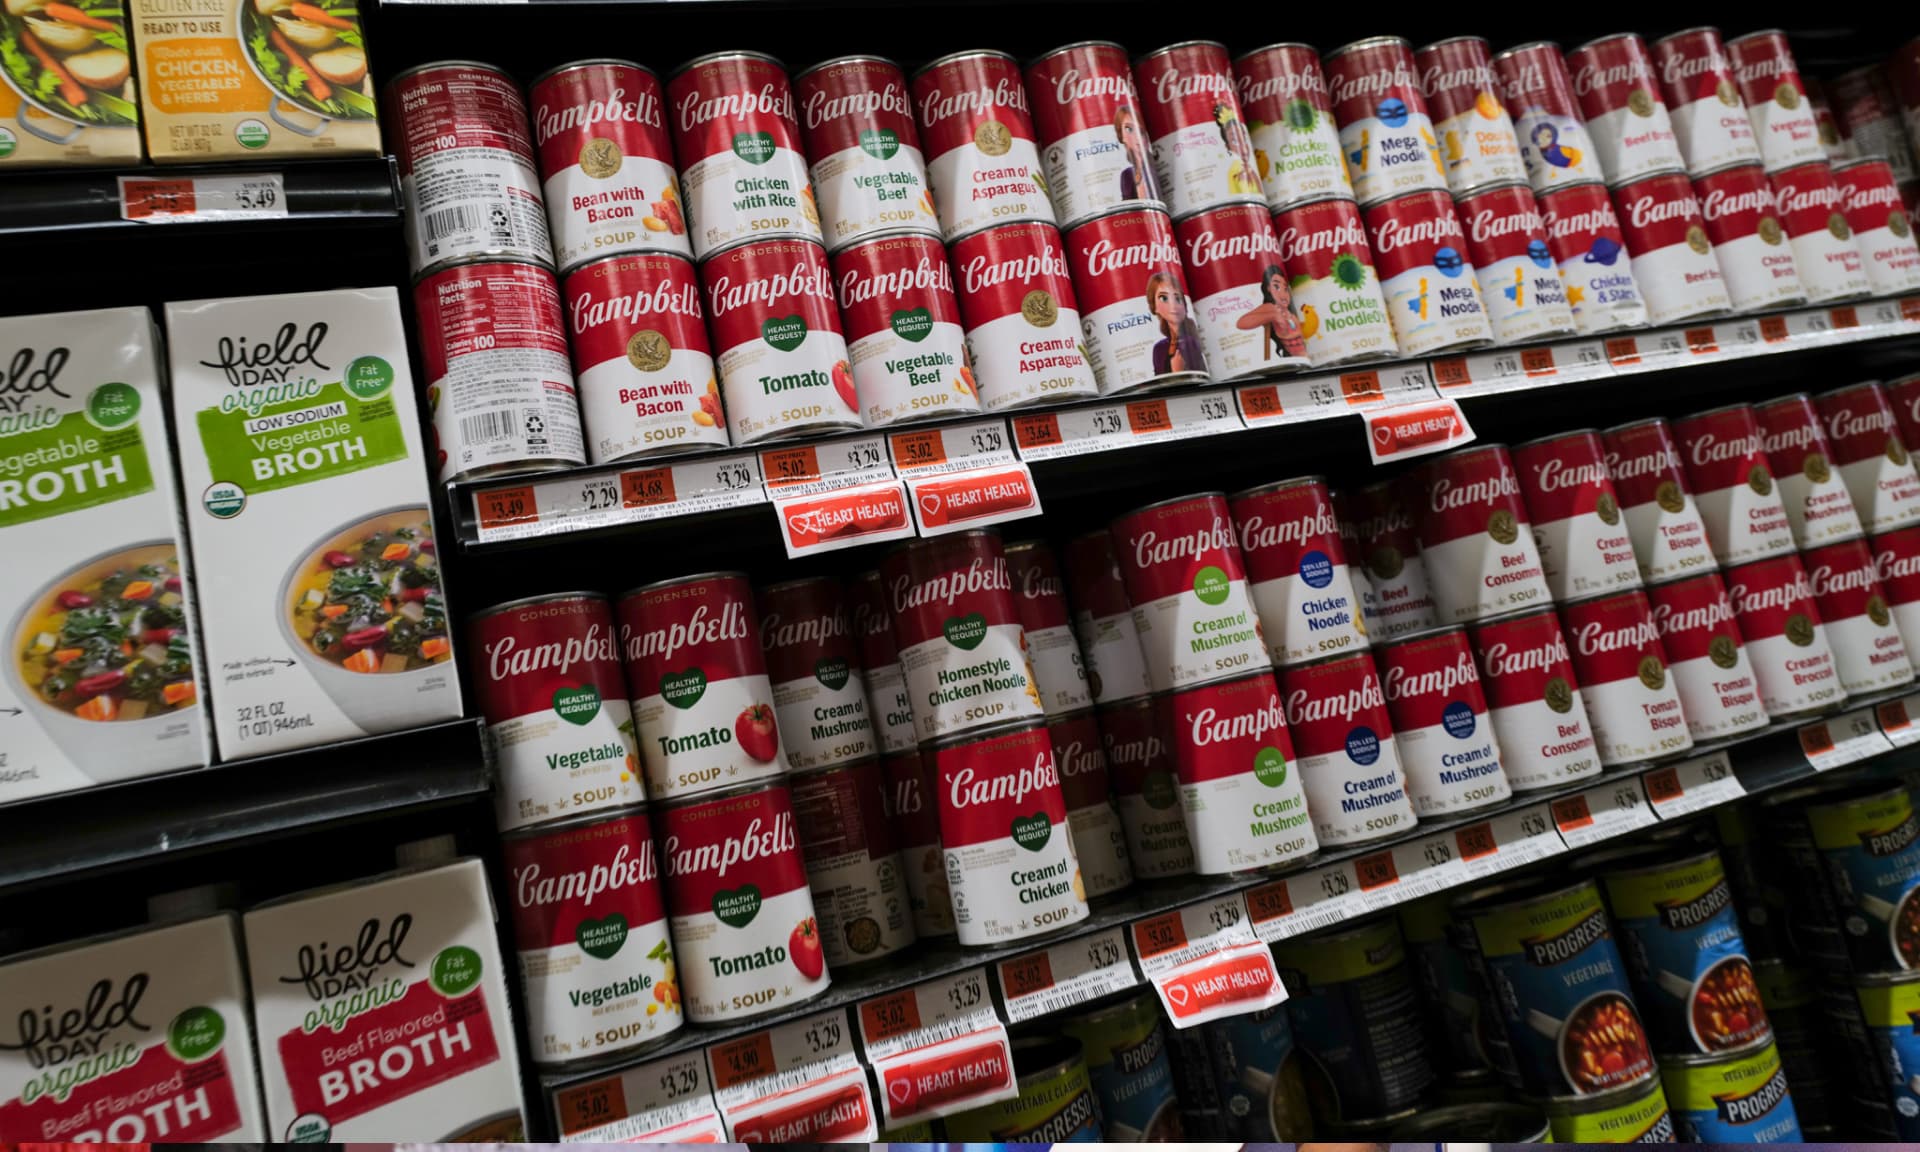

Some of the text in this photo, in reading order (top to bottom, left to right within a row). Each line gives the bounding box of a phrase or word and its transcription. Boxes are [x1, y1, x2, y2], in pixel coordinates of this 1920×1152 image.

[144, 22, 222, 34] READY TO USE
[156, 60, 245, 78] CHICKEN,
[159, 77, 241, 91] VEGETABLES
[402, 84, 442, 100] Nutrition
[161, 92, 219, 104] & HERBS
[405, 97, 428, 112] Facts
[435, 135, 456, 149] 100
[1075, 142, 1121, 161] FROZEN
[1379, 136, 1418, 153] Mega
[854, 171, 919, 189] Vegetable
[973, 166, 1028, 182] Cream of
[735, 178, 789, 193] Chicken
[877, 187, 907, 200] Beef
[972, 181, 1037, 201] Asparagus
[572, 186, 644, 210] Bean with
[733, 192, 796, 210] with Rice
[588, 206, 634, 223] Bacon
[594, 262, 670, 277] CONDENSED
[439, 280, 481, 294] Nutrition
[1440, 287, 1473, 302] Mega
[440, 293, 465, 305] Facts
[1329, 296, 1378, 316] Chicken
[1441, 301, 1482, 317] Noodle
[768, 322, 801, 336] HEALTHY
[896, 316, 928, 326] HEALTHY
[1107, 314, 1153, 334] FROZEN
[447, 335, 495, 349] Calories 100
[1020, 337, 1075, 355] Cream of
[200, 322, 331, 386] field
[885, 352, 954, 374] Vegetable
[1019, 354, 1082, 373] Asparagus
[244, 365, 292, 386] DAY
[359, 365, 378, 376] Fat
[909, 369, 941, 387] Beef
[759, 369, 830, 395] Tomato
[1040, 377, 1075, 391] SOUP
[103, 393, 124, 404] Fat
[222, 377, 322, 414] organic
[619, 381, 692, 404] Bean with
[249, 417, 283, 432] LOW
[286, 404, 344, 428] SODIUM
[636, 400, 683, 417] Bacon
[1025, 427, 1050, 440] $3.64
[1093, 415, 1122, 434] $2.39
[1394, 416, 1457, 438] HEART HEALTH
[252, 420, 351, 452] Vegetable
[971, 433, 1001, 453] $3.29
[252, 437, 367, 481] BROTH
[907, 443, 932, 459] $5.02
[582, 486, 618, 511] $2.29
[632, 480, 663, 497] $4.68
[946, 482, 1026, 508] HEART HEALTH
[491, 501, 524, 518] $3.49
[817, 502, 900, 528] HEART HEALTH
[1501, 553, 1527, 568] Beef
[1302, 596, 1348, 615] Chicken
[1193, 611, 1248, 635] Cream of
[1308, 612, 1350, 632] Noodle
[1190, 627, 1255, 653] Mushroom
[1215, 653, 1250, 670] SOUP
[937, 658, 1011, 686] Homestyle
[665, 676, 700, 691] HEALTHY
[928, 673, 1027, 707] Chicken Noodle
[558, 693, 596, 707] HEALTHY
[237, 702, 285, 721] 32 FL OZ
[965, 703, 1004, 721] SOUP
[274, 714, 313, 731] 946mL
[810, 717, 869, 740] Mushroom
[1557, 721, 1581, 739] Beef
[658, 726, 732, 757] Tomato
[834, 741, 866, 758] SOUP
[546, 743, 623, 772] Vegetable
[1441, 744, 1492, 767] Cream of
[1344, 771, 1396, 795] Cream of
[1439, 761, 1500, 786] Mushroom
[1252, 801, 1291, 819] Cream
[1342, 789, 1404, 813] Mushroom
[1016, 821, 1046, 834] HEALTHY
[1011, 859, 1068, 887] Cream of
[718, 893, 755, 909] HEALTHY
[1019, 880, 1070, 905] Chicken
[1033, 907, 1069, 927] SOUP
[1209, 907, 1240, 930] $3.29
[582, 922, 621, 939] HEALTHY
[279, 913, 416, 1001] field
[446, 957, 466, 970] Fat
[710, 945, 786, 978] Tomato
[325, 968, 378, 998] DAY
[1192, 967, 1269, 997] HEART HEALTH
[1562, 960, 1614, 987] VEGETABLE
[569, 973, 652, 1008] Vegetable
[732, 988, 777, 1010] SOUP
[948, 983, 981, 1010] $3.29
[305, 978, 408, 1033] organic
[0, 974, 150, 1069] field
[186, 1017, 208, 1031] Fat
[876, 1006, 905, 1026] $5.02
[322, 1038, 364, 1067] Beef
[368, 1006, 446, 1048] Flavored
[594, 1024, 641, 1046] SOUP
[806, 1024, 841, 1052] $3.29
[49, 1036, 101, 1067] DAY
[21, 1041, 141, 1102] organic
[319, 1028, 472, 1106] BROTH
[917, 1058, 1003, 1095] HEART HEALTH
[660, 1072, 699, 1098] $3.29
[43, 1076, 183, 1138] Beef Flavored
[768, 1102, 862, 1143] HEART HEALTH
